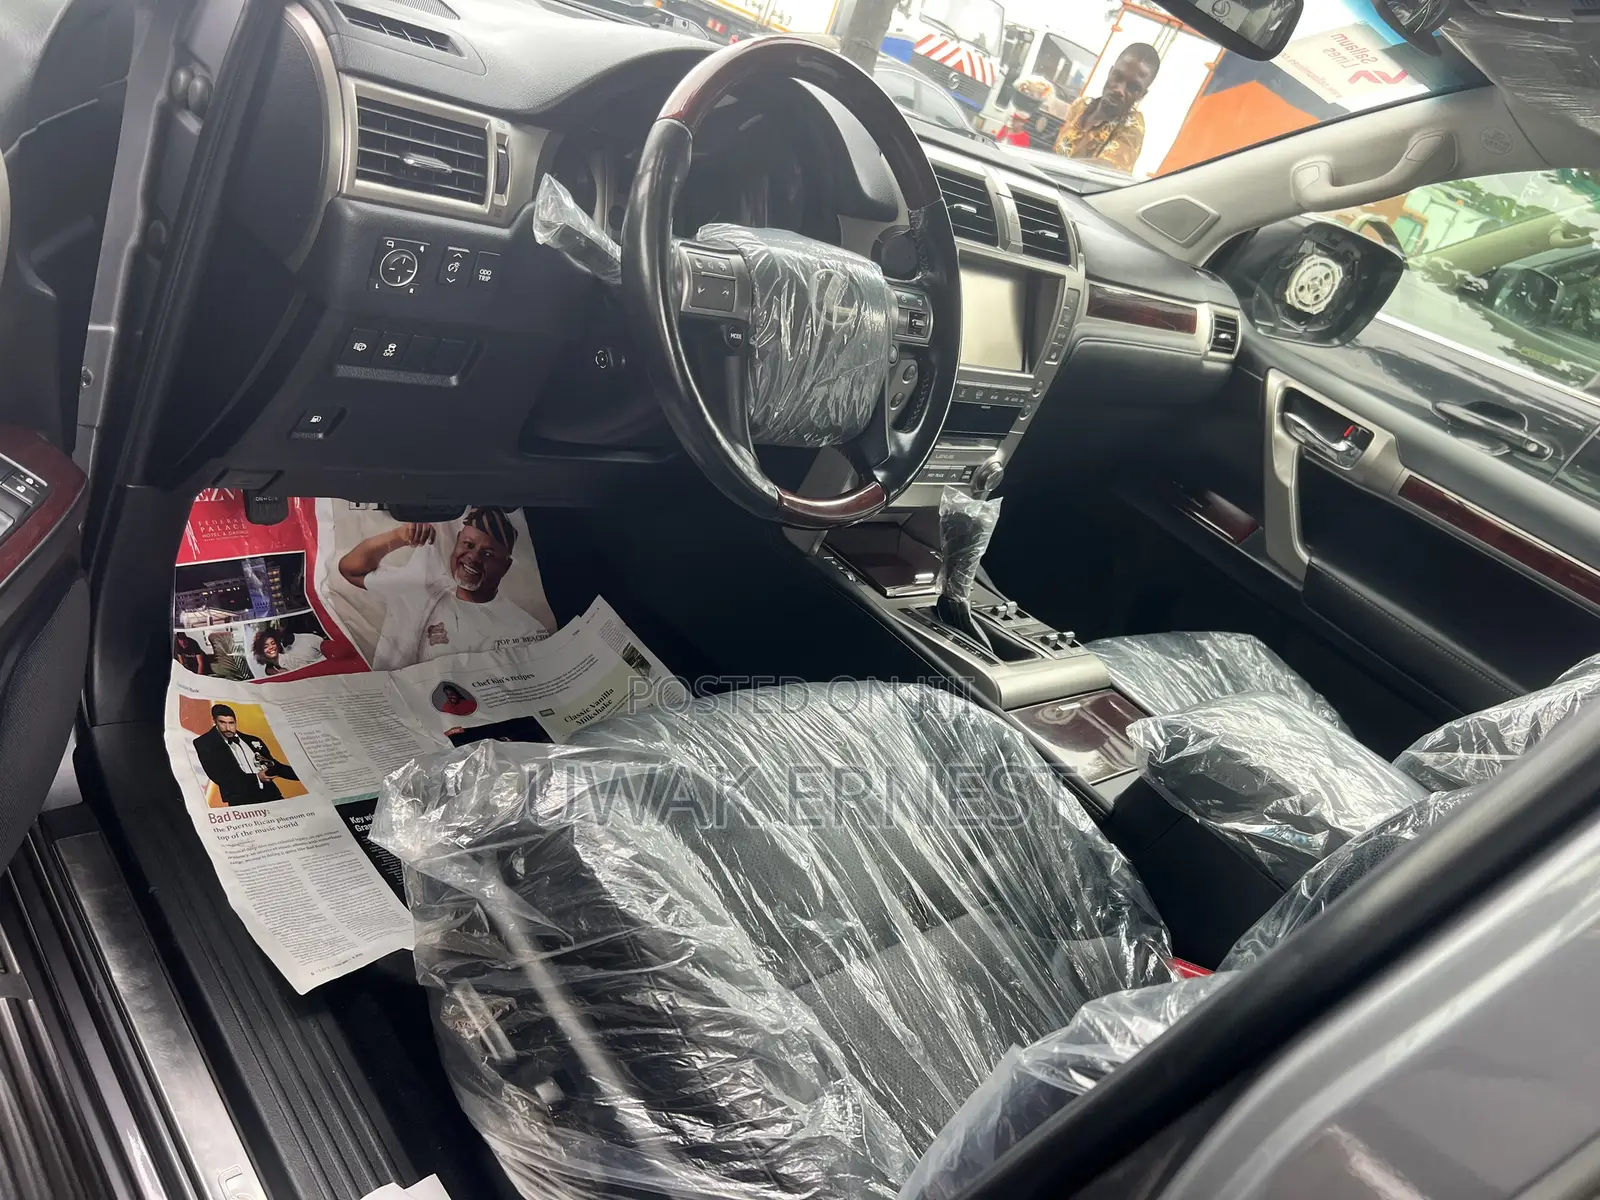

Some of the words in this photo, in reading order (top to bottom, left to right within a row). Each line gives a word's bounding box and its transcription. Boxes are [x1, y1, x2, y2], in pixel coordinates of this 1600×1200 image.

[478, 274, 491, 282] TRIP
[730, 332, 742, 340] MODE
[198, 518, 245, 526] FEDERAL
[200, 523, 248, 533] PALACE
[472, 679, 490, 688] Chef
[510, 673, 535, 681] recipes
[564, 708, 591, 723] Classic
[589, 688, 614, 708] Vanilla
[576, 699, 612, 725] Milkshake
[208, 811, 231, 824] Bad
[232, 809, 270, 820] Bunny:
[349, 816, 364, 824] Key
[227, 822, 253, 832] Puerto
[254, 818, 276, 826] Rican
[276, 814, 305, 824] phenom
[277, 821, 299, 829] world
